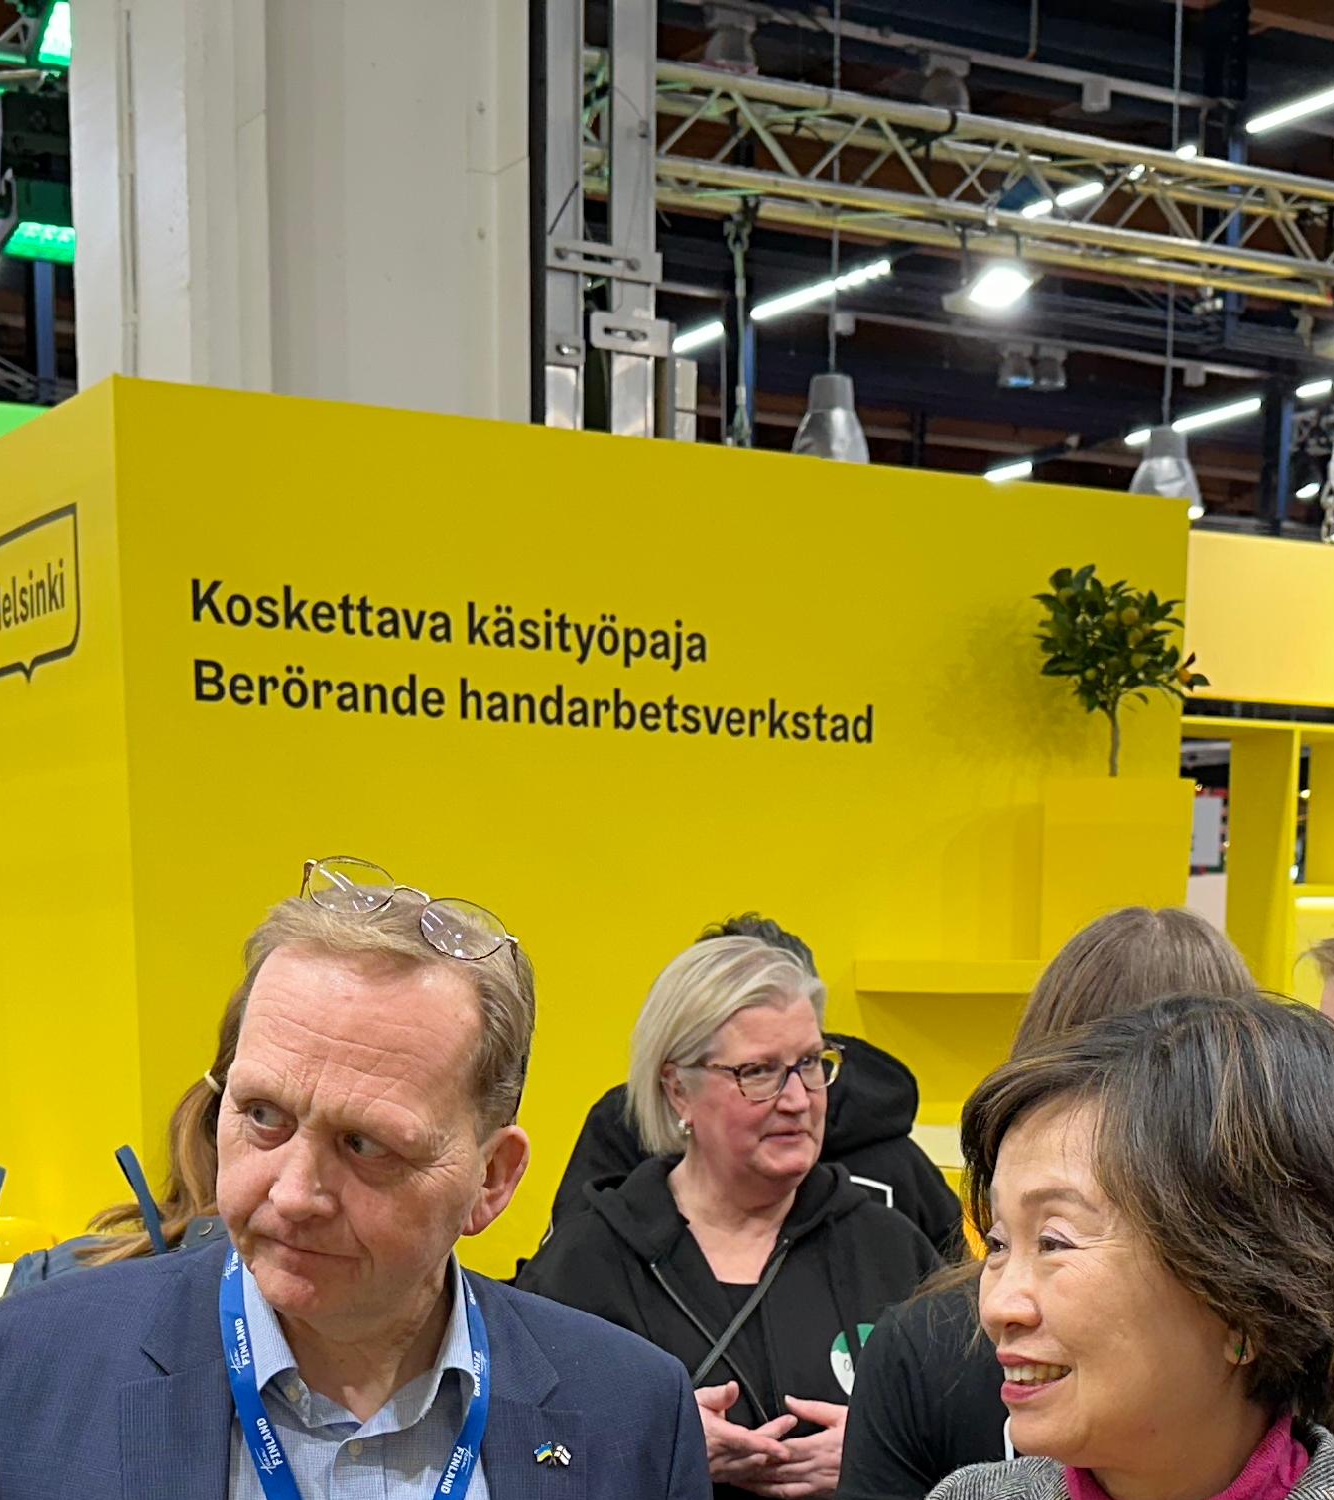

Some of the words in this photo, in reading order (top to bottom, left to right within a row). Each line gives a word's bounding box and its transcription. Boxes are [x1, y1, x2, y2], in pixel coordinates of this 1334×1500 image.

[190, 578, 453, 643] Koskettava
[466, 601, 708, 671] käsityöpaja
[193, 658, 446, 718] Berörande
[459, 677, 874, 745] handarbetsverkstad
[234, 1317, 250, 1366] FINLAND
[473, 1350, 482, 1398] FINLAND
[256, 1417, 283, 1466] FINLAND
[440, 1445, 464, 1496] FINLAND
